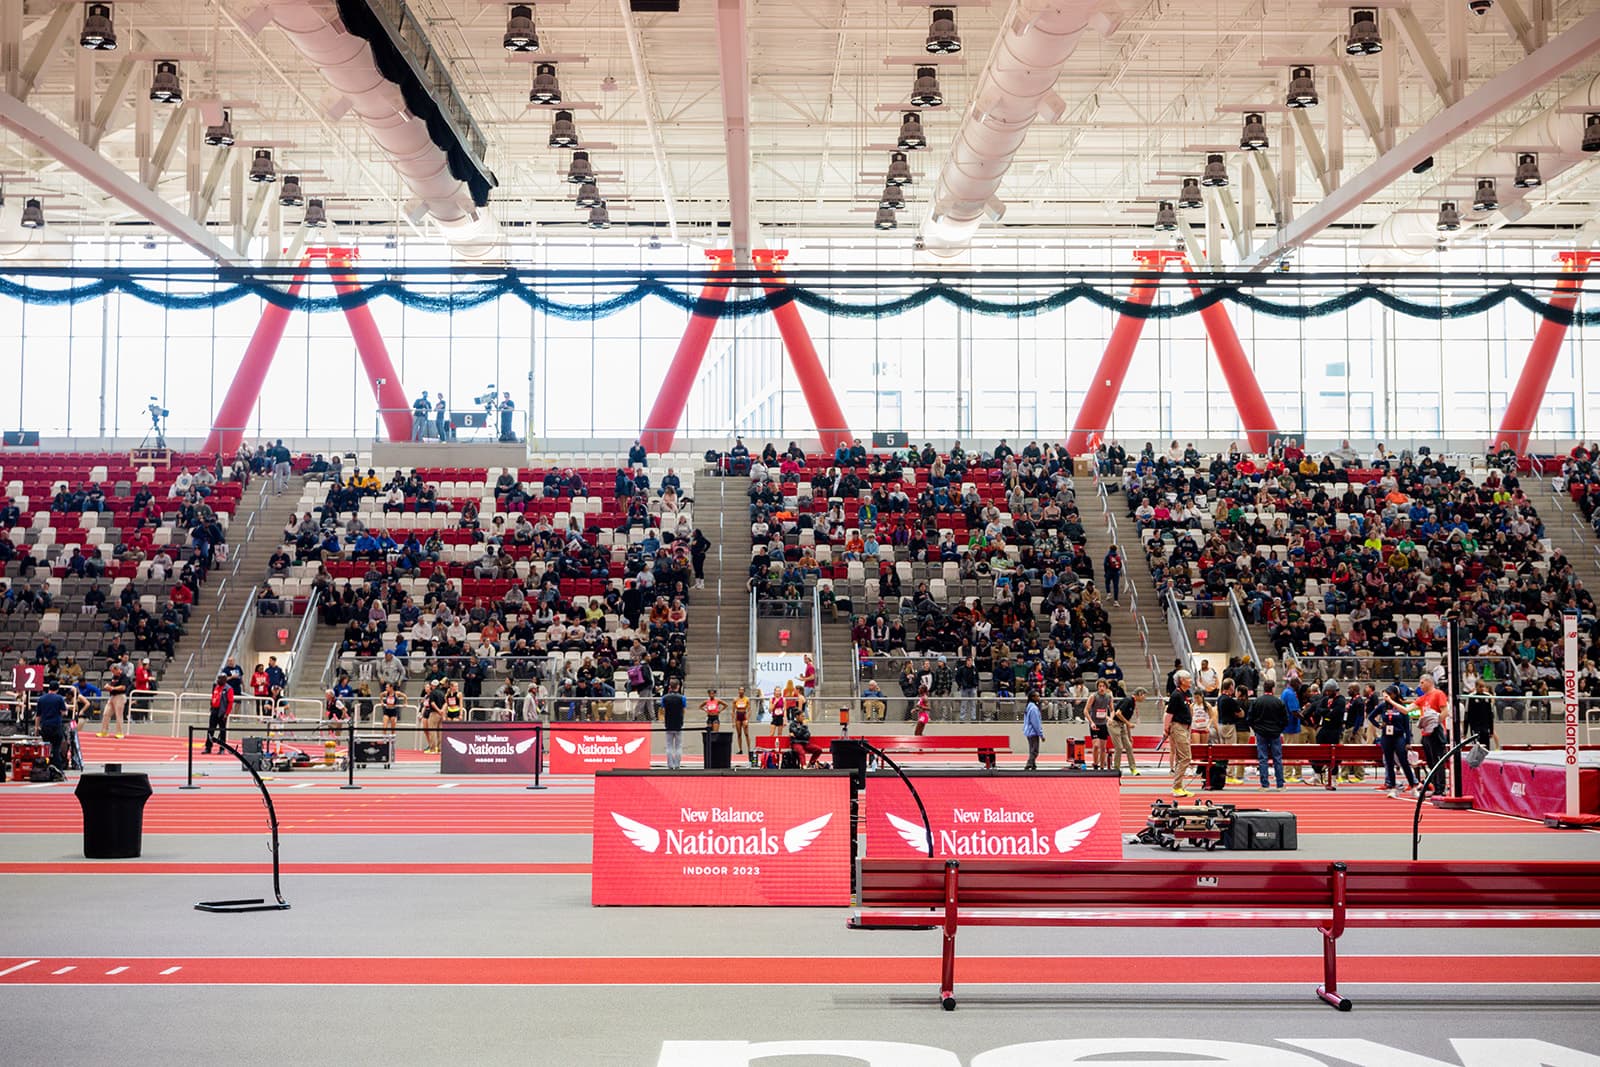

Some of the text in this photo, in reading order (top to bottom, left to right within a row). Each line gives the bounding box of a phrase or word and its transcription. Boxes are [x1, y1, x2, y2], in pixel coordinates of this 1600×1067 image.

[464, 415, 473, 426] 6
[17, 433, 25, 444] 7
[886, 434, 895, 446] 5
[1282, 436, 1290, 448] 4
[24, 667, 36, 689] 2
[1566, 670, 1578, 765] new balance
[468, 743, 515, 755] Nationals
[577, 743, 624, 755] Nationals
[680, 806, 764, 822] New Balance
[953, 807, 1035, 823] New Balance
[664, 826, 779, 855] Nationals
[939, 827, 1050, 856] Nationals
[683, 866, 760, 875] INDOOR 2023
